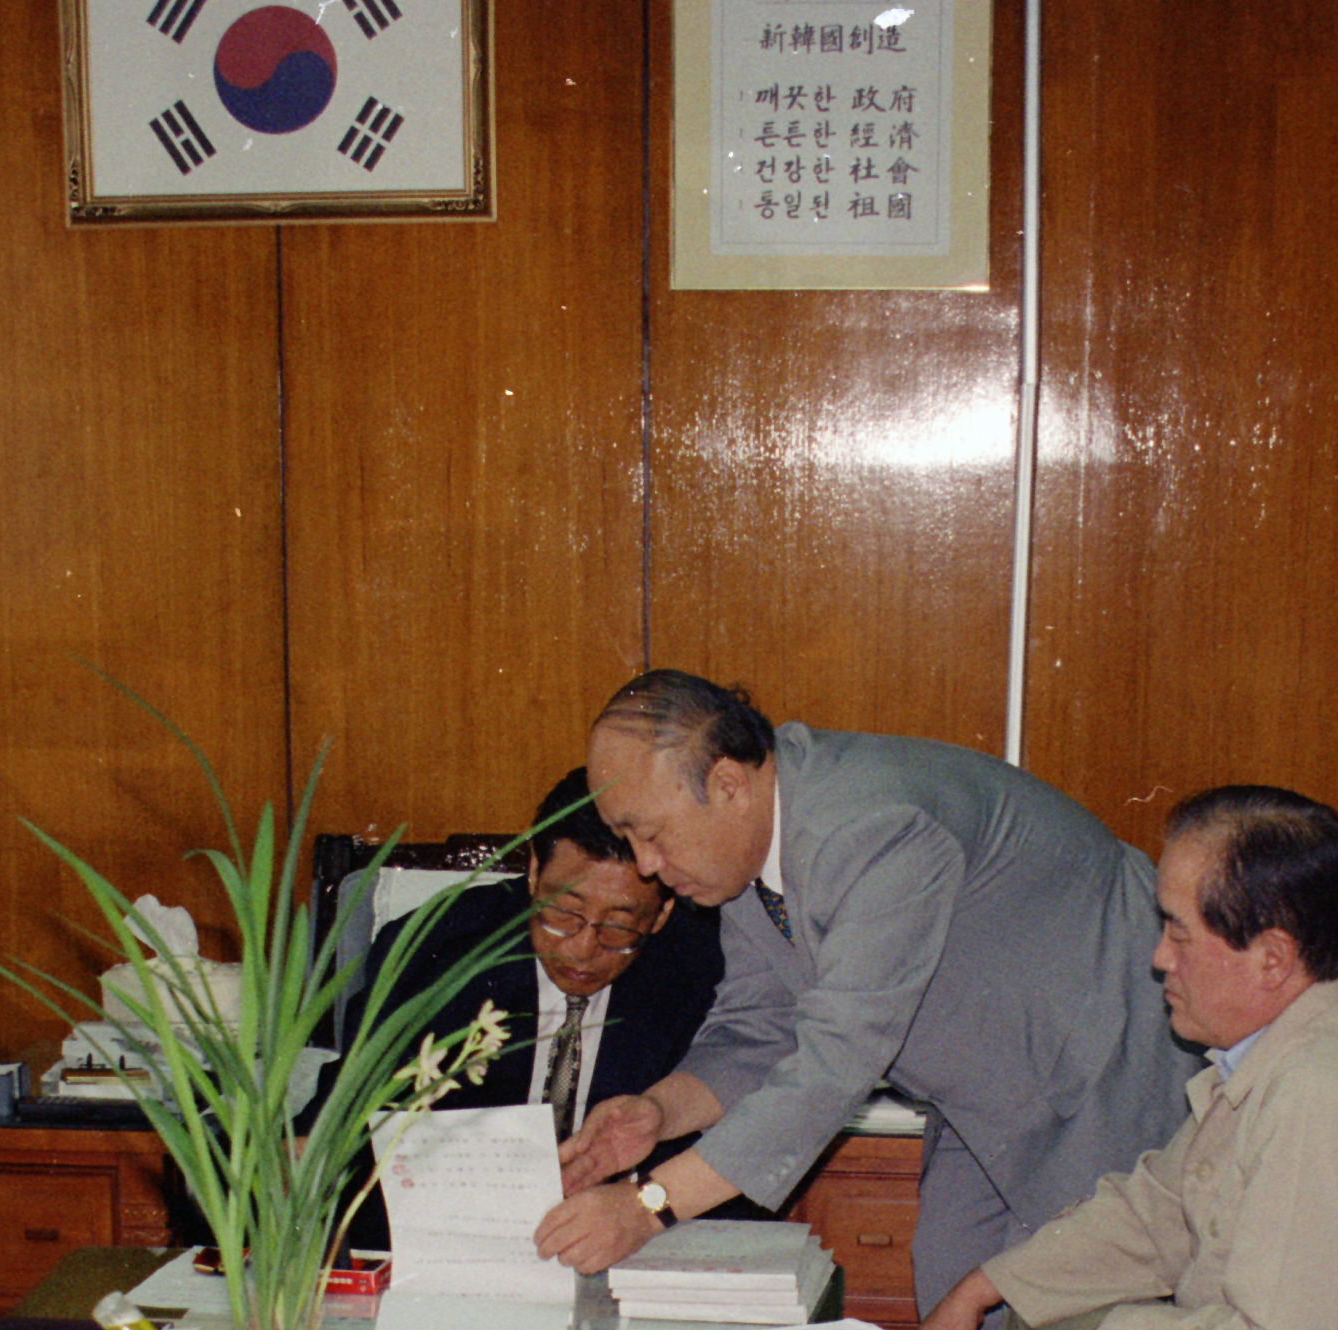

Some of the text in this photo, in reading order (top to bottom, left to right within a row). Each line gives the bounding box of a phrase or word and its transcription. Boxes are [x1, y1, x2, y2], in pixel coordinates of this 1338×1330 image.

[759, 22, 907, 55] 新韓國創造
[755, 83, 918, 113] 깨끗한 政府
[754, 120, 920, 151] 튼튼한 經濟
[755, 155, 920, 185] 건강한 社會
[754, 190, 912, 220] 통일된 祖國
